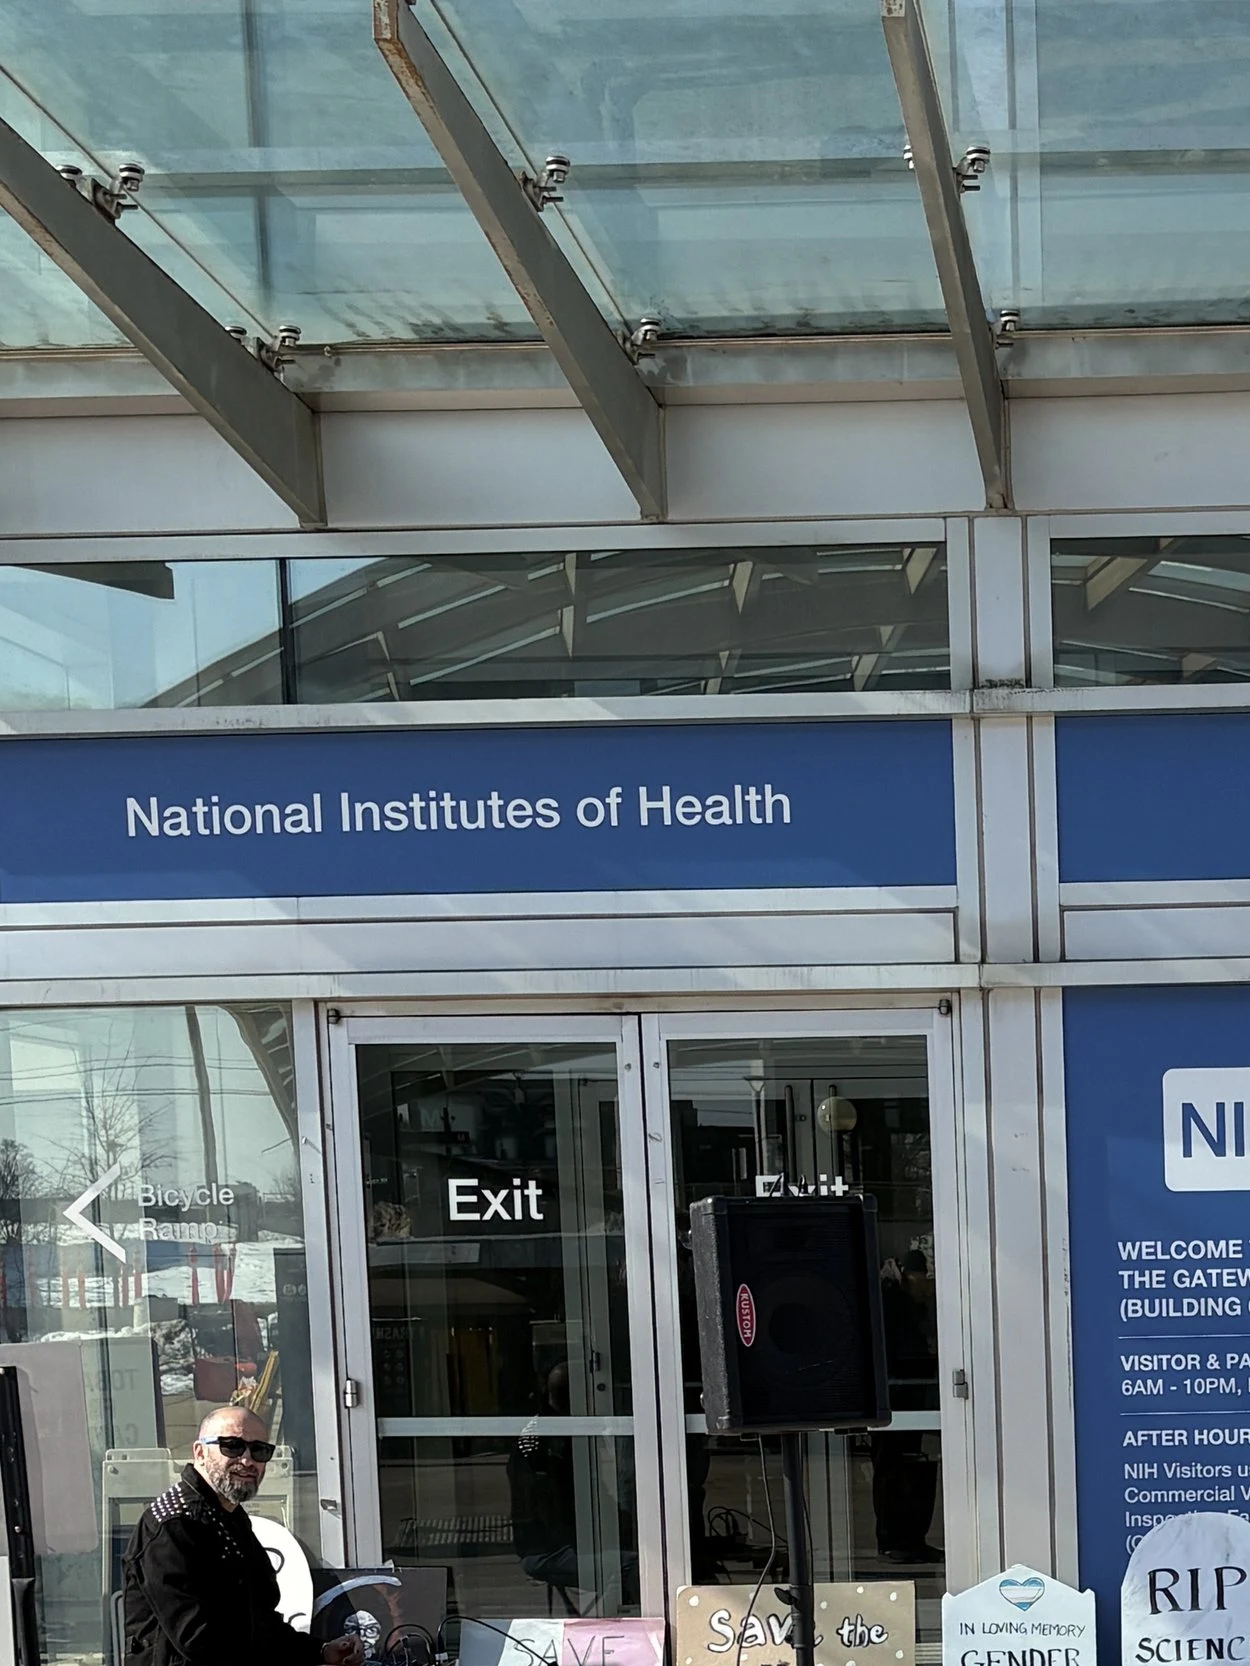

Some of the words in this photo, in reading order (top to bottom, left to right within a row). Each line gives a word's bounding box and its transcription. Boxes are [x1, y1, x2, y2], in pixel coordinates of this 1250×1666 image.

[126, 793, 322, 837] National
[340, 789, 561, 832] Institutes
[576, 786, 622, 827] of
[639, 783, 791, 827] Health
[137, 1183, 235, 1212] Bicycle
[448, 1178, 544, 1221] Exit
[138, 1217, 218, 1243] Ramp
[1118, 1239, 1243, 1261] WELCOME
[1119, 1270, 1166, 1290] THE
[740, 1291, 752, 1339] KUSTOM
[1120, 1298, 1242, 1321] (BUILDING
[1120, 1353, 1201, 1372] VISITOR
[1207, 1353, 1221, 1370] &
[1122, 1378, 1164, 1395] 6AM
[1183, 1378, 1242, 1397] 10PM,
[1123, 1429, 1188, 1447] AFTER
[1124, 1463, 1158, 1480] NIH
[1163, 1462, 1232, 1479] Visitors
[1124, 1486, 1235, 1503] Commercial
[1147, 1565, 1248, 1616] RIP
[708, 1608, 823, 1653] Sav
[837, 1613, 889, 1649] the
[959, 1622, 975, 1635] IN
[982, 1622, 1028, 1635] LOVING
[1031, 1622, 1087, 1638] MEMORY
